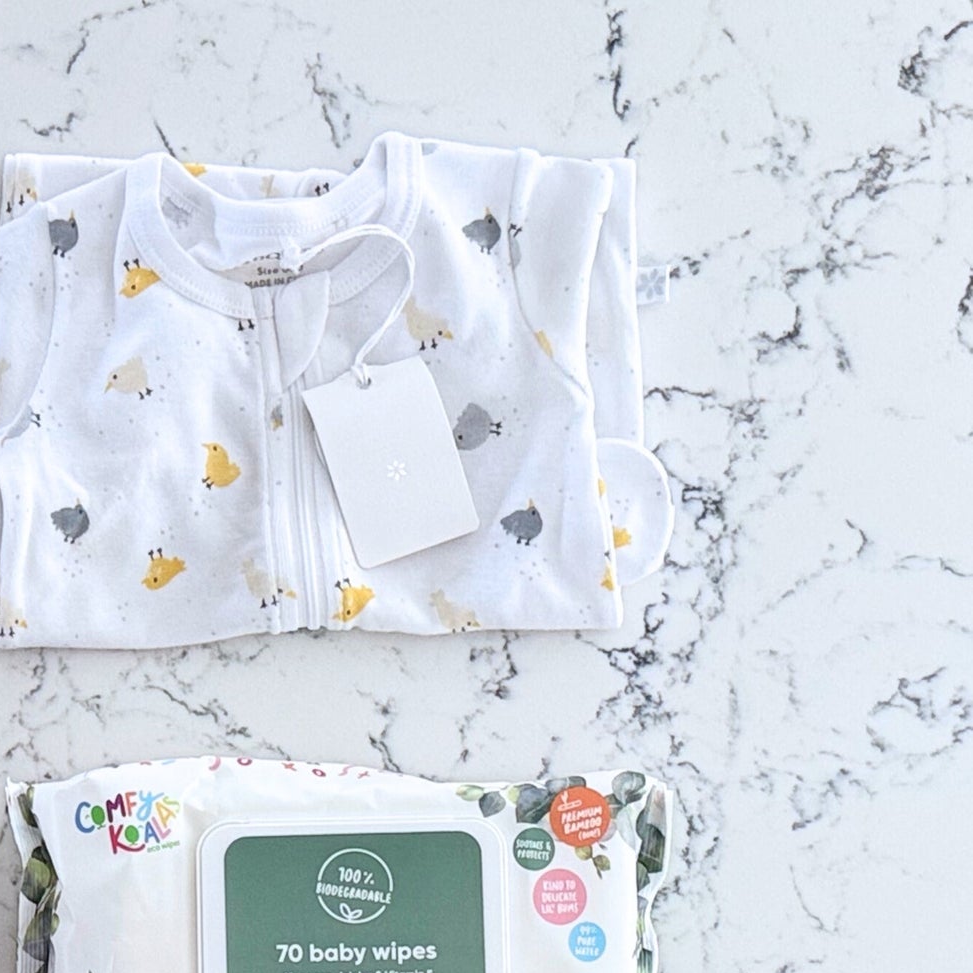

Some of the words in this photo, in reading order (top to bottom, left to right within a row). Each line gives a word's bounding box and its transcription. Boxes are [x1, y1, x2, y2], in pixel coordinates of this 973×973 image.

[338, 866, 375, 885] 100%
[315, 881, 392, 905] BIODEGRADABLE
[541, 891, 577, 903] DELICATE
[276, 943, 303, 963] 70
[309, 942, 367, 966] baby
[372, 941, 438, 965] wipes
